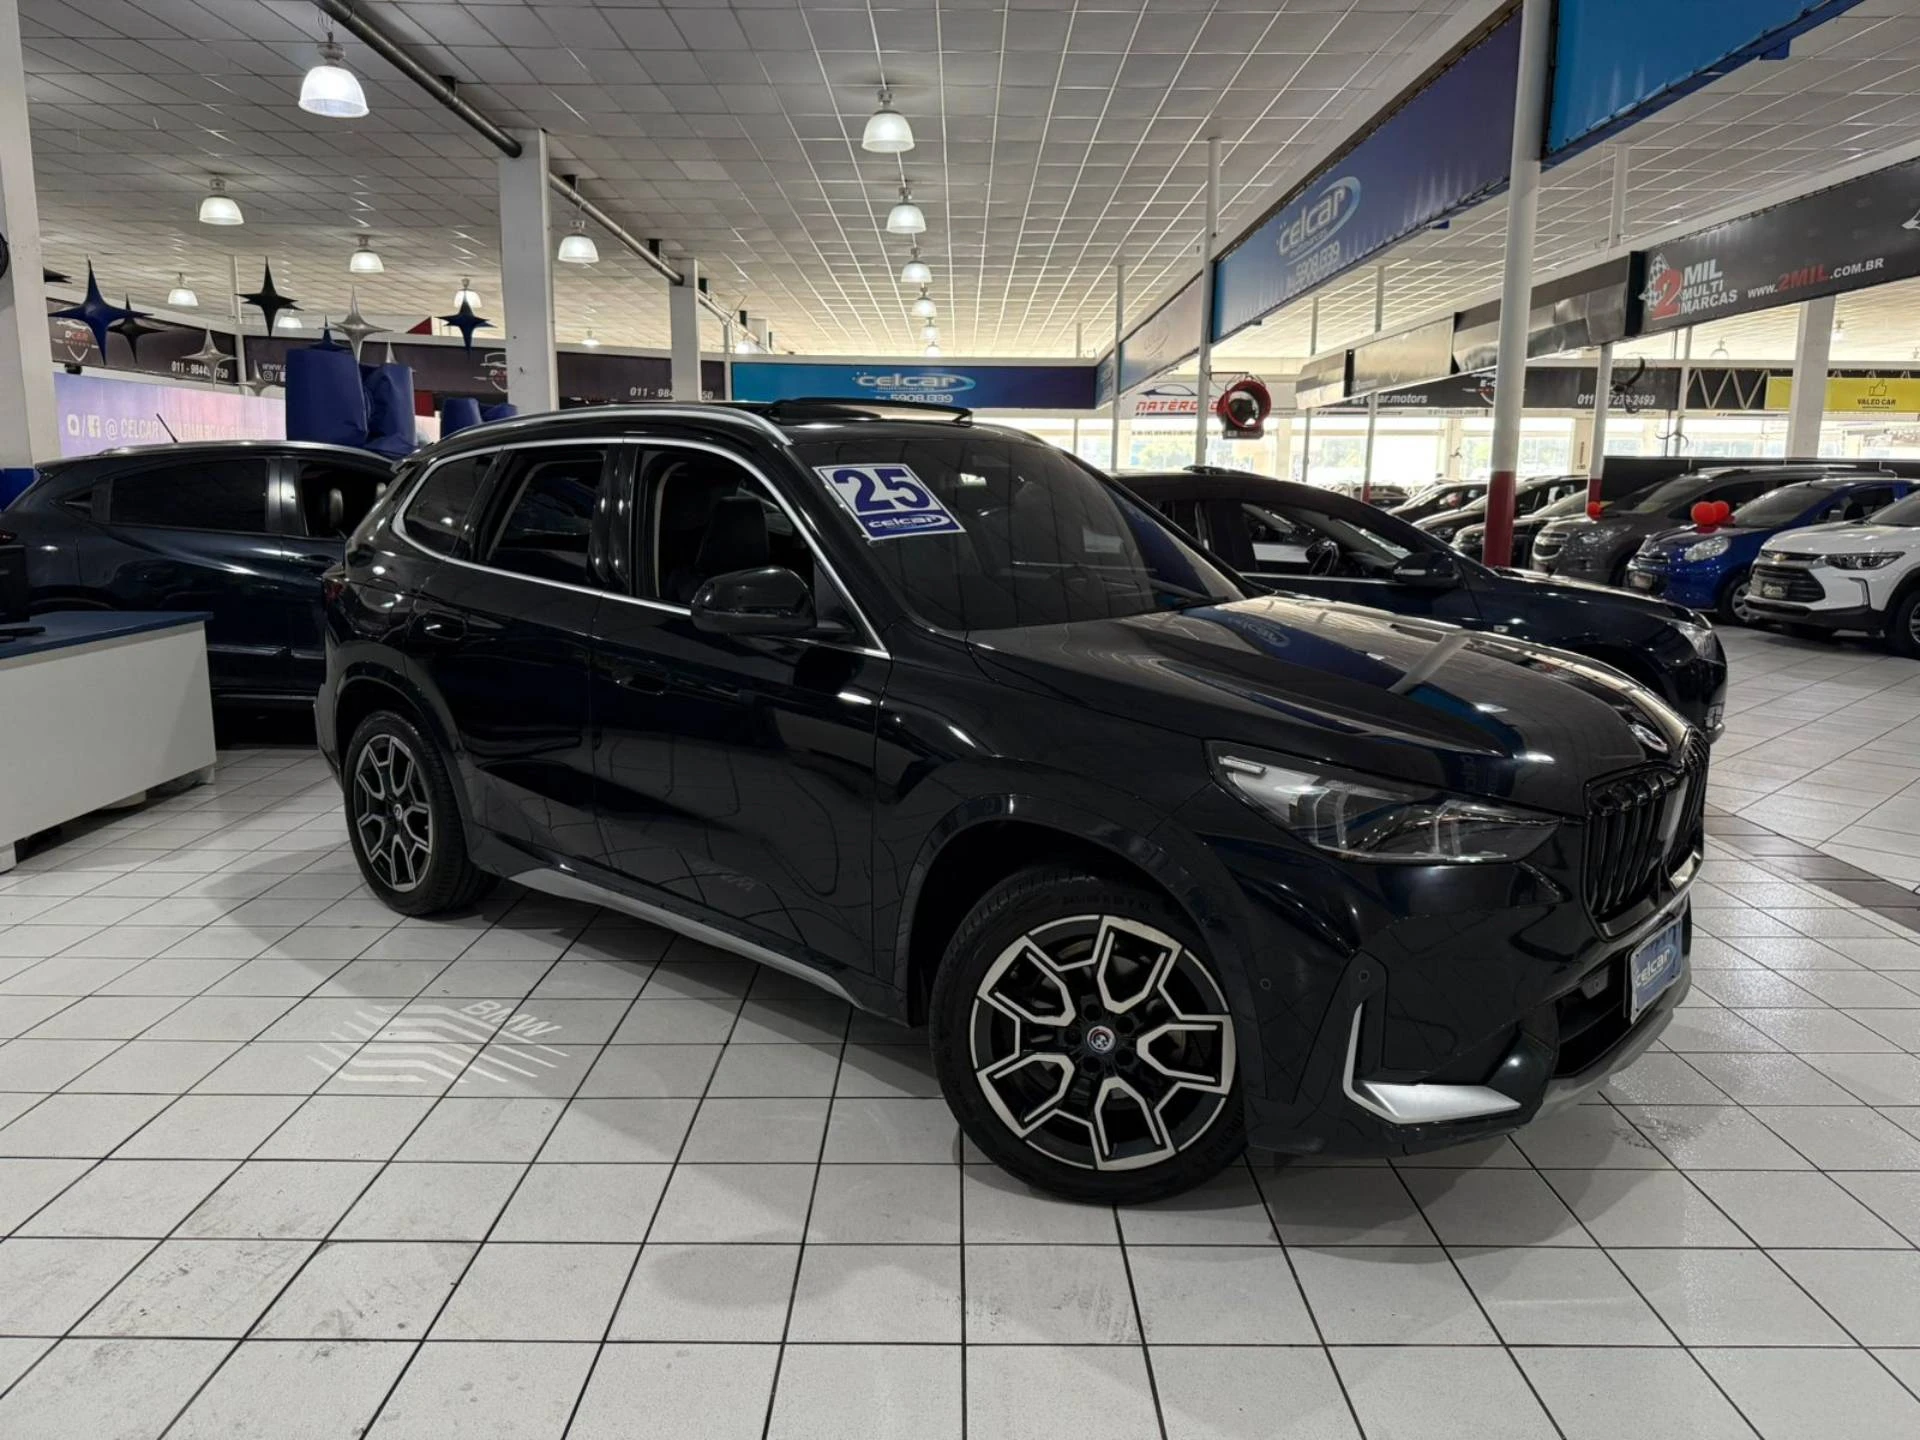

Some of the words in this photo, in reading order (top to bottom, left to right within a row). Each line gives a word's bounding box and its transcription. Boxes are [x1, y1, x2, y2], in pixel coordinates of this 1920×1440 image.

[1279, 186, 1345, 256] celcar
[1652, 268, 1683, 320] 2
[1684, 259, 1723, 287] MIL
[1682, 280, 1723, 301] MULTI
[1681, 289, 1738, 315] MARCAS
[857, 373, 958, 387] celcar
[629, 387, 648, 397] 011
[1577, 394, 1594, 405] 011
[832, 468, 931, 513] 25
[868, 515, 938, 529] celcar
[459, 1000, 563, 1037] BMW
